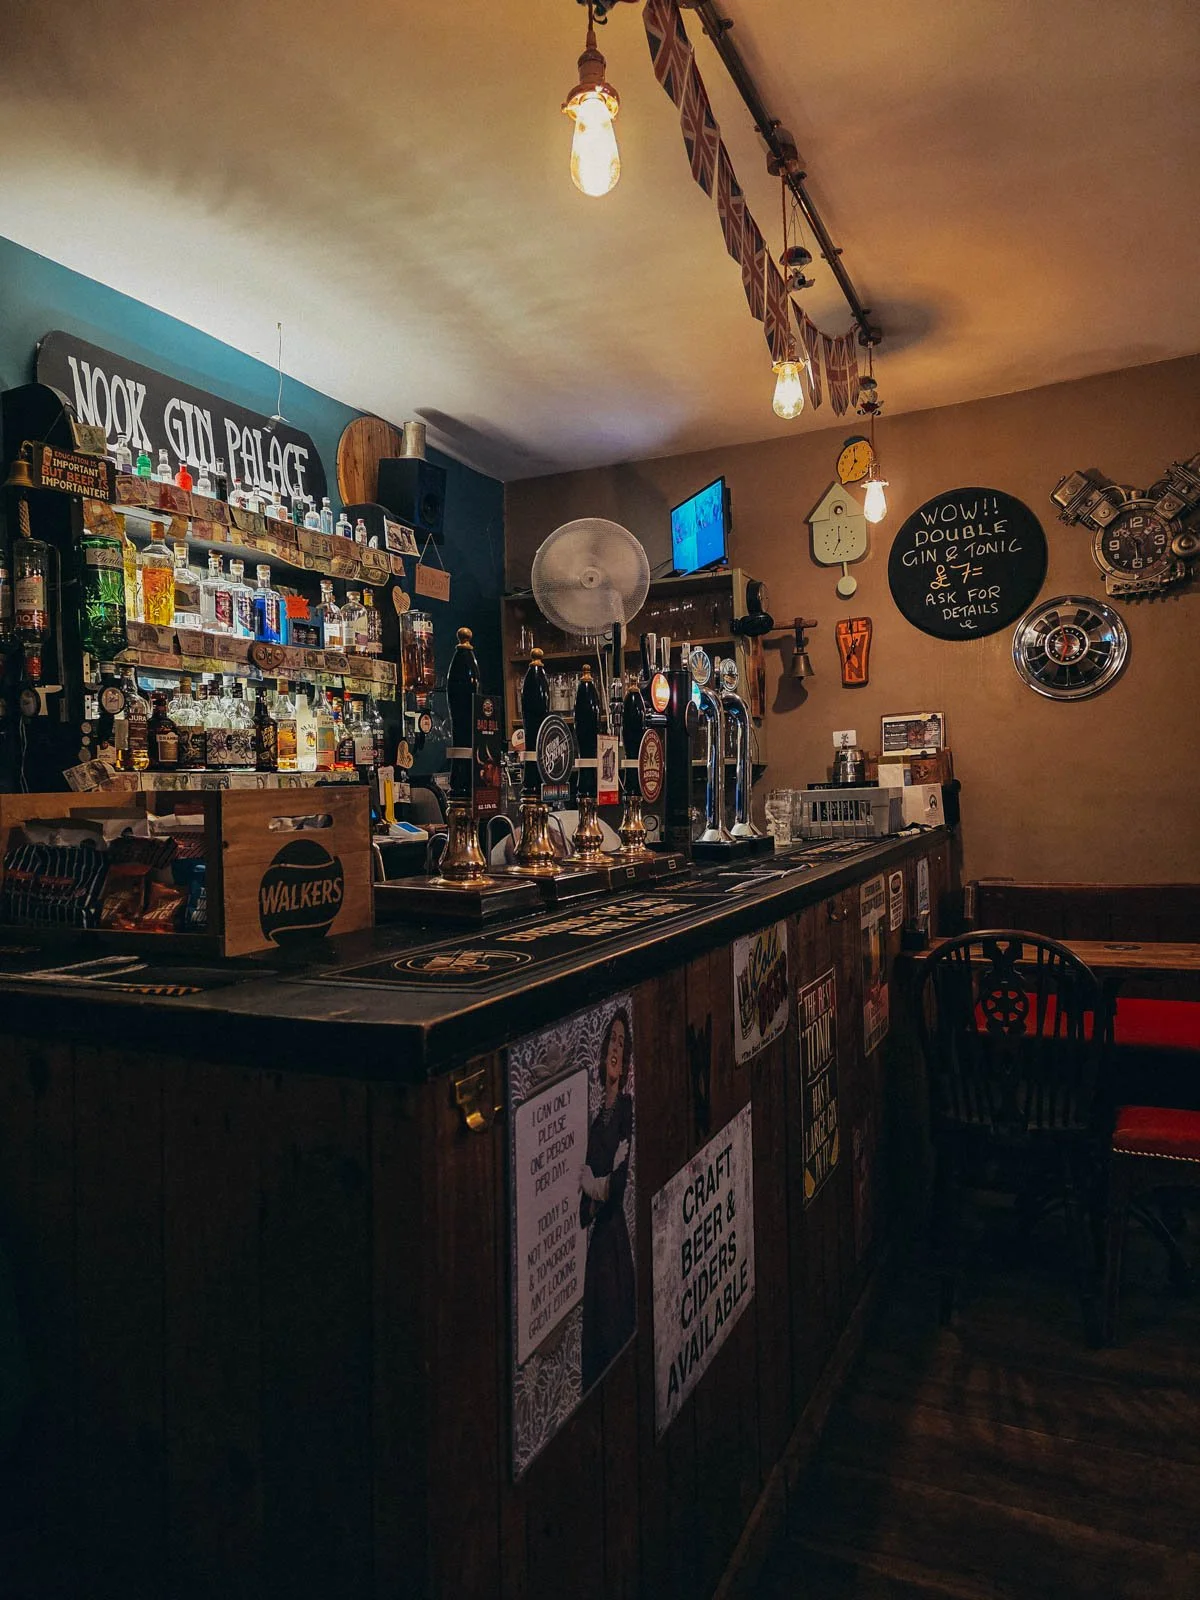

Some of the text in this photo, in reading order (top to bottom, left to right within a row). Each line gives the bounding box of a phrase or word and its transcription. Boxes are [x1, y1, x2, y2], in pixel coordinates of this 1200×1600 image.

[68, 356, 313, 500] NOOK GIN PALACE
[41, 464, 63, 479] BUT
[67, 471, 95, 487] BEER
[53, 458, 98, 477] IMPORTANT
[41, 475, 109, 500] IMPORTANTER!
[920, 497, 999, 526] WOW!!
[1130, 516, 1144, 529] 12
[915, 519, 1008, 547] DOUBLE
[1109, 540, 1120, 552] 9
[1154, 533, 1166, 546] 3
[902, 538, 1022, 567] GIN & TONIC
[925, 585, 1001, 606] ASK FOR
[941, 602, 999, 620] DETAILS
[130, 713, 147, 722] JURA
[261, 877, 342, 916] WALKERS
[537, 1100, 552, 1124] CAN
[554, 1088, 572, 1113] ONLY
[538, 1114, 566, 1146] PLEASE
[530, 1131, 575, 1176] ONE PERSON
[536, 1171, 550, 1197] PER
[682, 1143, 733, 1225] CRAFT
[538, 1196, 569, 1236] TODAY IS
[528, 1212, 577, 1270] NOT YOUR DAY
[682, 1189, 736, 1280] BEER &
[538, 1232, 577, 1283] TOMORROW
[549, 1256, 577, 1296] LOOKING
[680, 1230, 736, 1330] CIDERS
[666, 1257, 748, 1408] AVAILABLE
